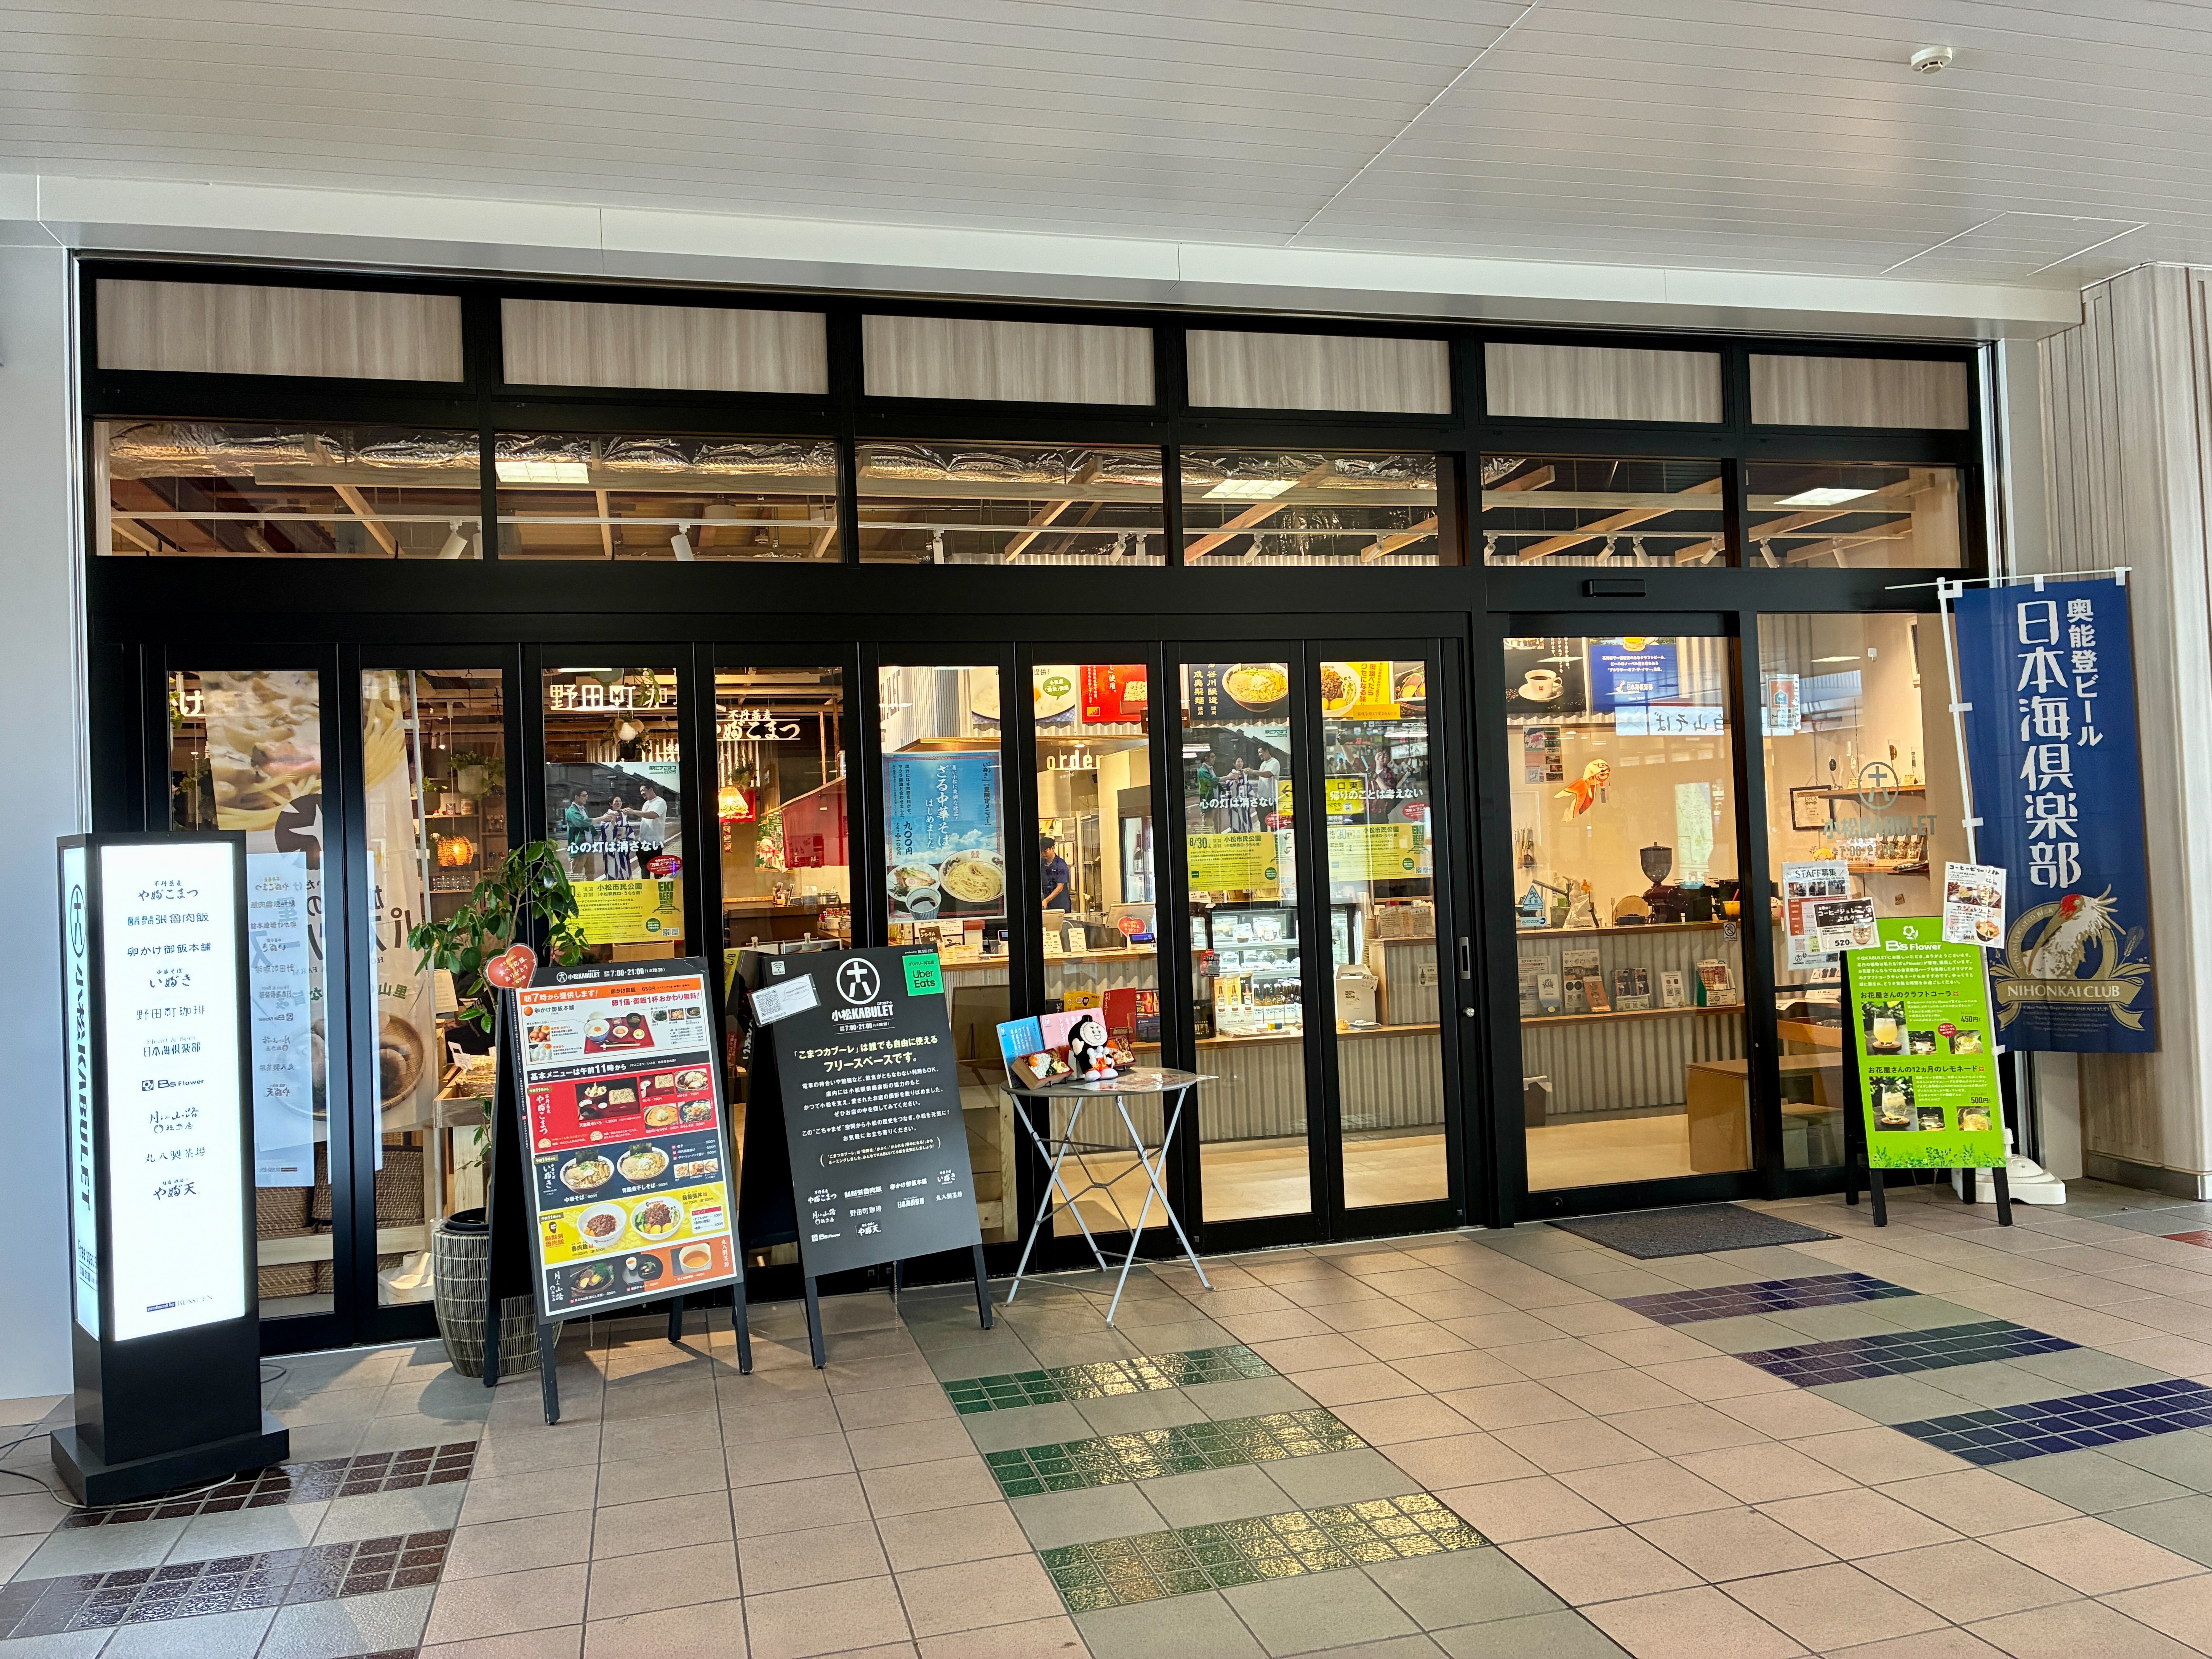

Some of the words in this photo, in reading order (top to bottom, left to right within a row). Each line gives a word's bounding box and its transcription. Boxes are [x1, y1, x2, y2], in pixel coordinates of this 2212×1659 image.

[2067, 599, 2103, 747] 奥能登ビール
[2017, 601, 2082, 888] 日本海倶楽部
[1046, 749, 1103, 770] order
[1330, 788, 1424, 801] 帰りのことは考えない
[1199, 797, 1278, 809] 心の灯は消さない
[926, 799, 934, 849] はじめました
[1822, 814, 1937, 840] 小松KABULET
[567, 840, 664, 854] 心の灯は消さない
[1189, 836, 1207, 849] 8/30
[1795, 868, 1837, 878] STAFF募集
[597, 882, 642, 891] 小松市民公園
[658, 881, 674, 892] EKI
[127, 942, 211, 957] 卵かけ御飯本舗
[1909, 943, 1942, 951] Flower
[505, 964, 528, 982] ありがとう
[912, 970, 934, 979] Uber
[914, 979, 936, 988] Eats
[524, 989, 598, 1003] 朝7時から提供します!
[1860, 991, 1951, 1000] お花屋さんのクラフトコーラ
[2008, 986, 2081, 997] NIHONKAI
[2083, 986, 2120, 998] CLUB
[137, 1005, 205, 1020] 野田町珈琲
[534, 1005, 574, 1014] 卵かけ御飯本舗
[832, 1005, 893, 1022] 小松KABULET
[143, 1042, 201, 1057] 日本海倶楽部
[794, 1035, 938, 1059] 「こまつカブーレ」は誰でも自由に使える
[824, 1051, 917, 1072] フリースペースです。
[530, 1063, 627, 1081] 基本メニューは午前11時から
[826, 1079, 920, 1097] 店内には小松駅前商店街の協力のもと
[843, 1125, 917, 1142] お気軽にお立ち寄りください。
[144, 1147, 206, 1164] 丸八製茶場
[890, 1178, 927, 1190] 卵かけ御飯本舗
[564, 1194, 585, 1203] 中華そば
[850, 1205, 882, 1217] 野田町珈琲
[571, 1243, 589, 1252] 魯肉飯
